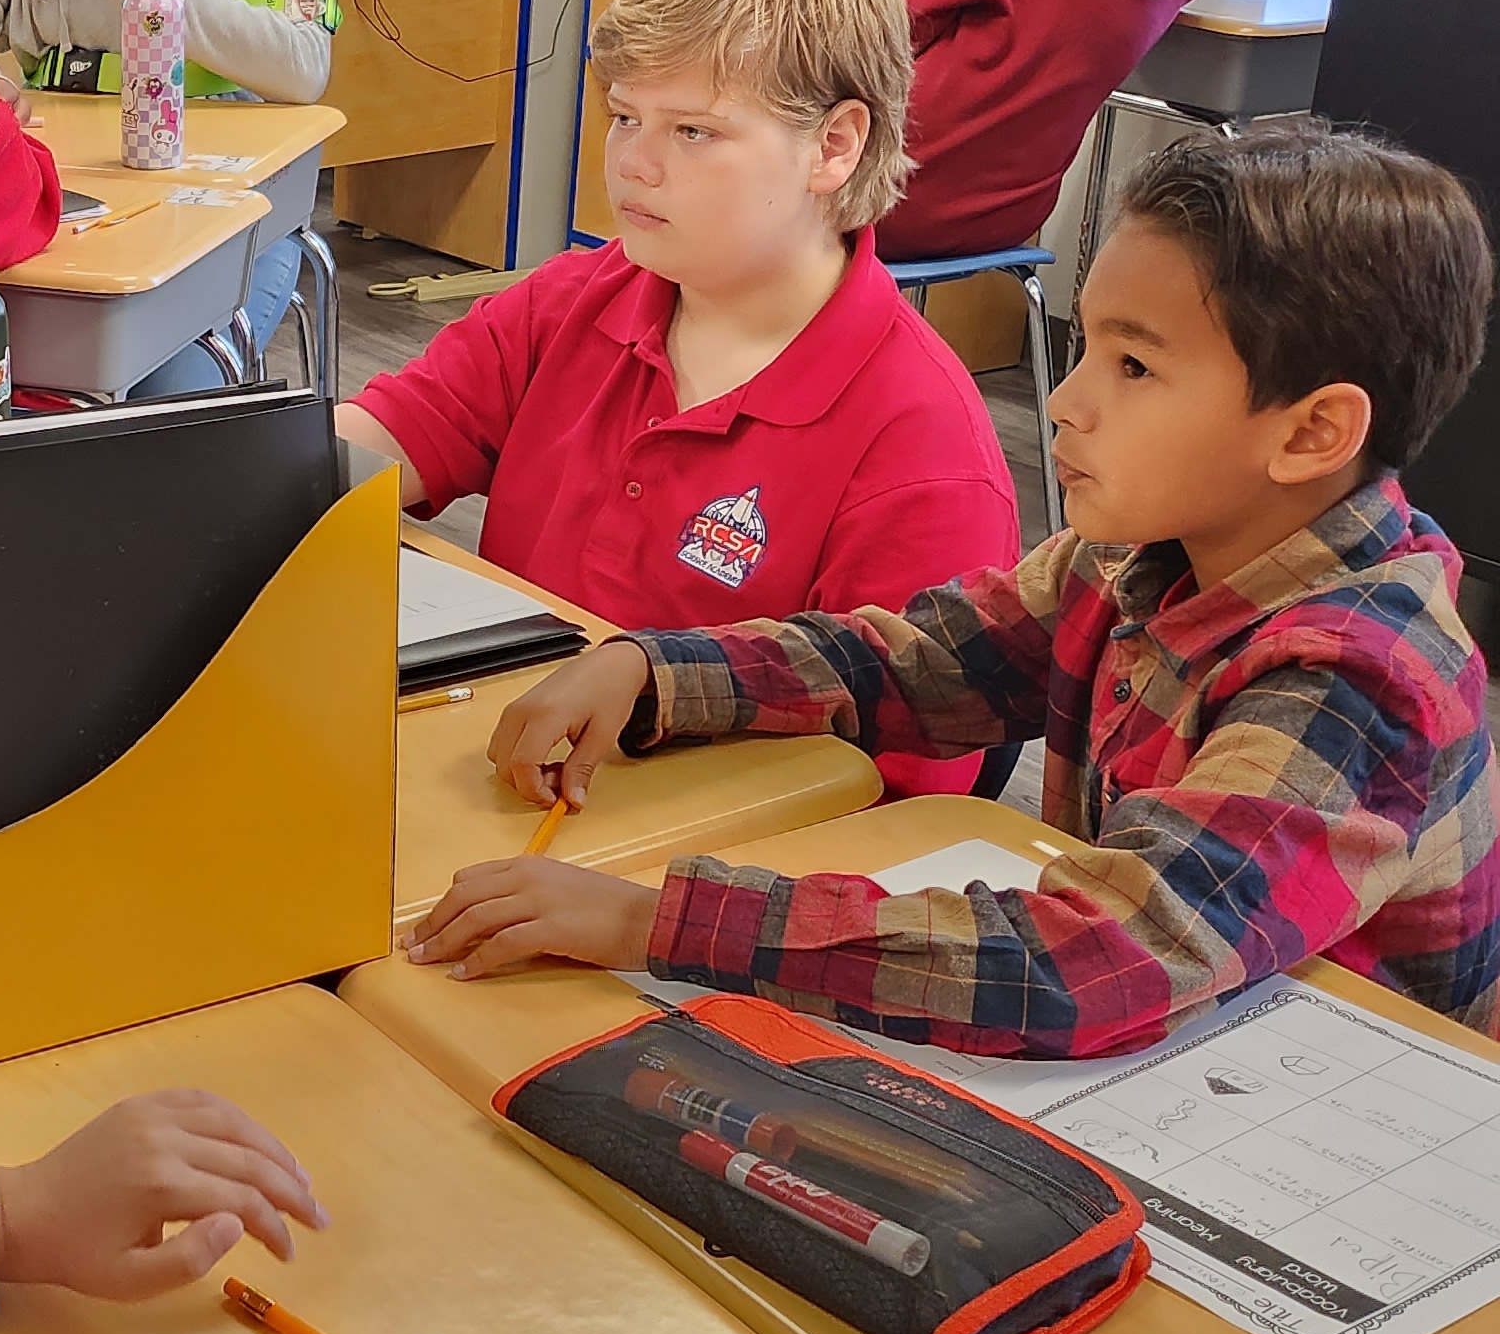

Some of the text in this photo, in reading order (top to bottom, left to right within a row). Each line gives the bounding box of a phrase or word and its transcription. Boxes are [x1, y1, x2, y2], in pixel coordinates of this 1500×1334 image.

[693, 516, 764, 564] RCSA
[1142, 1197, 1350, 1319] Vocabulary Meaning
[1279, 1262, 1339, 1295] Word
[1253, 1297, 1304, 1331] Title
